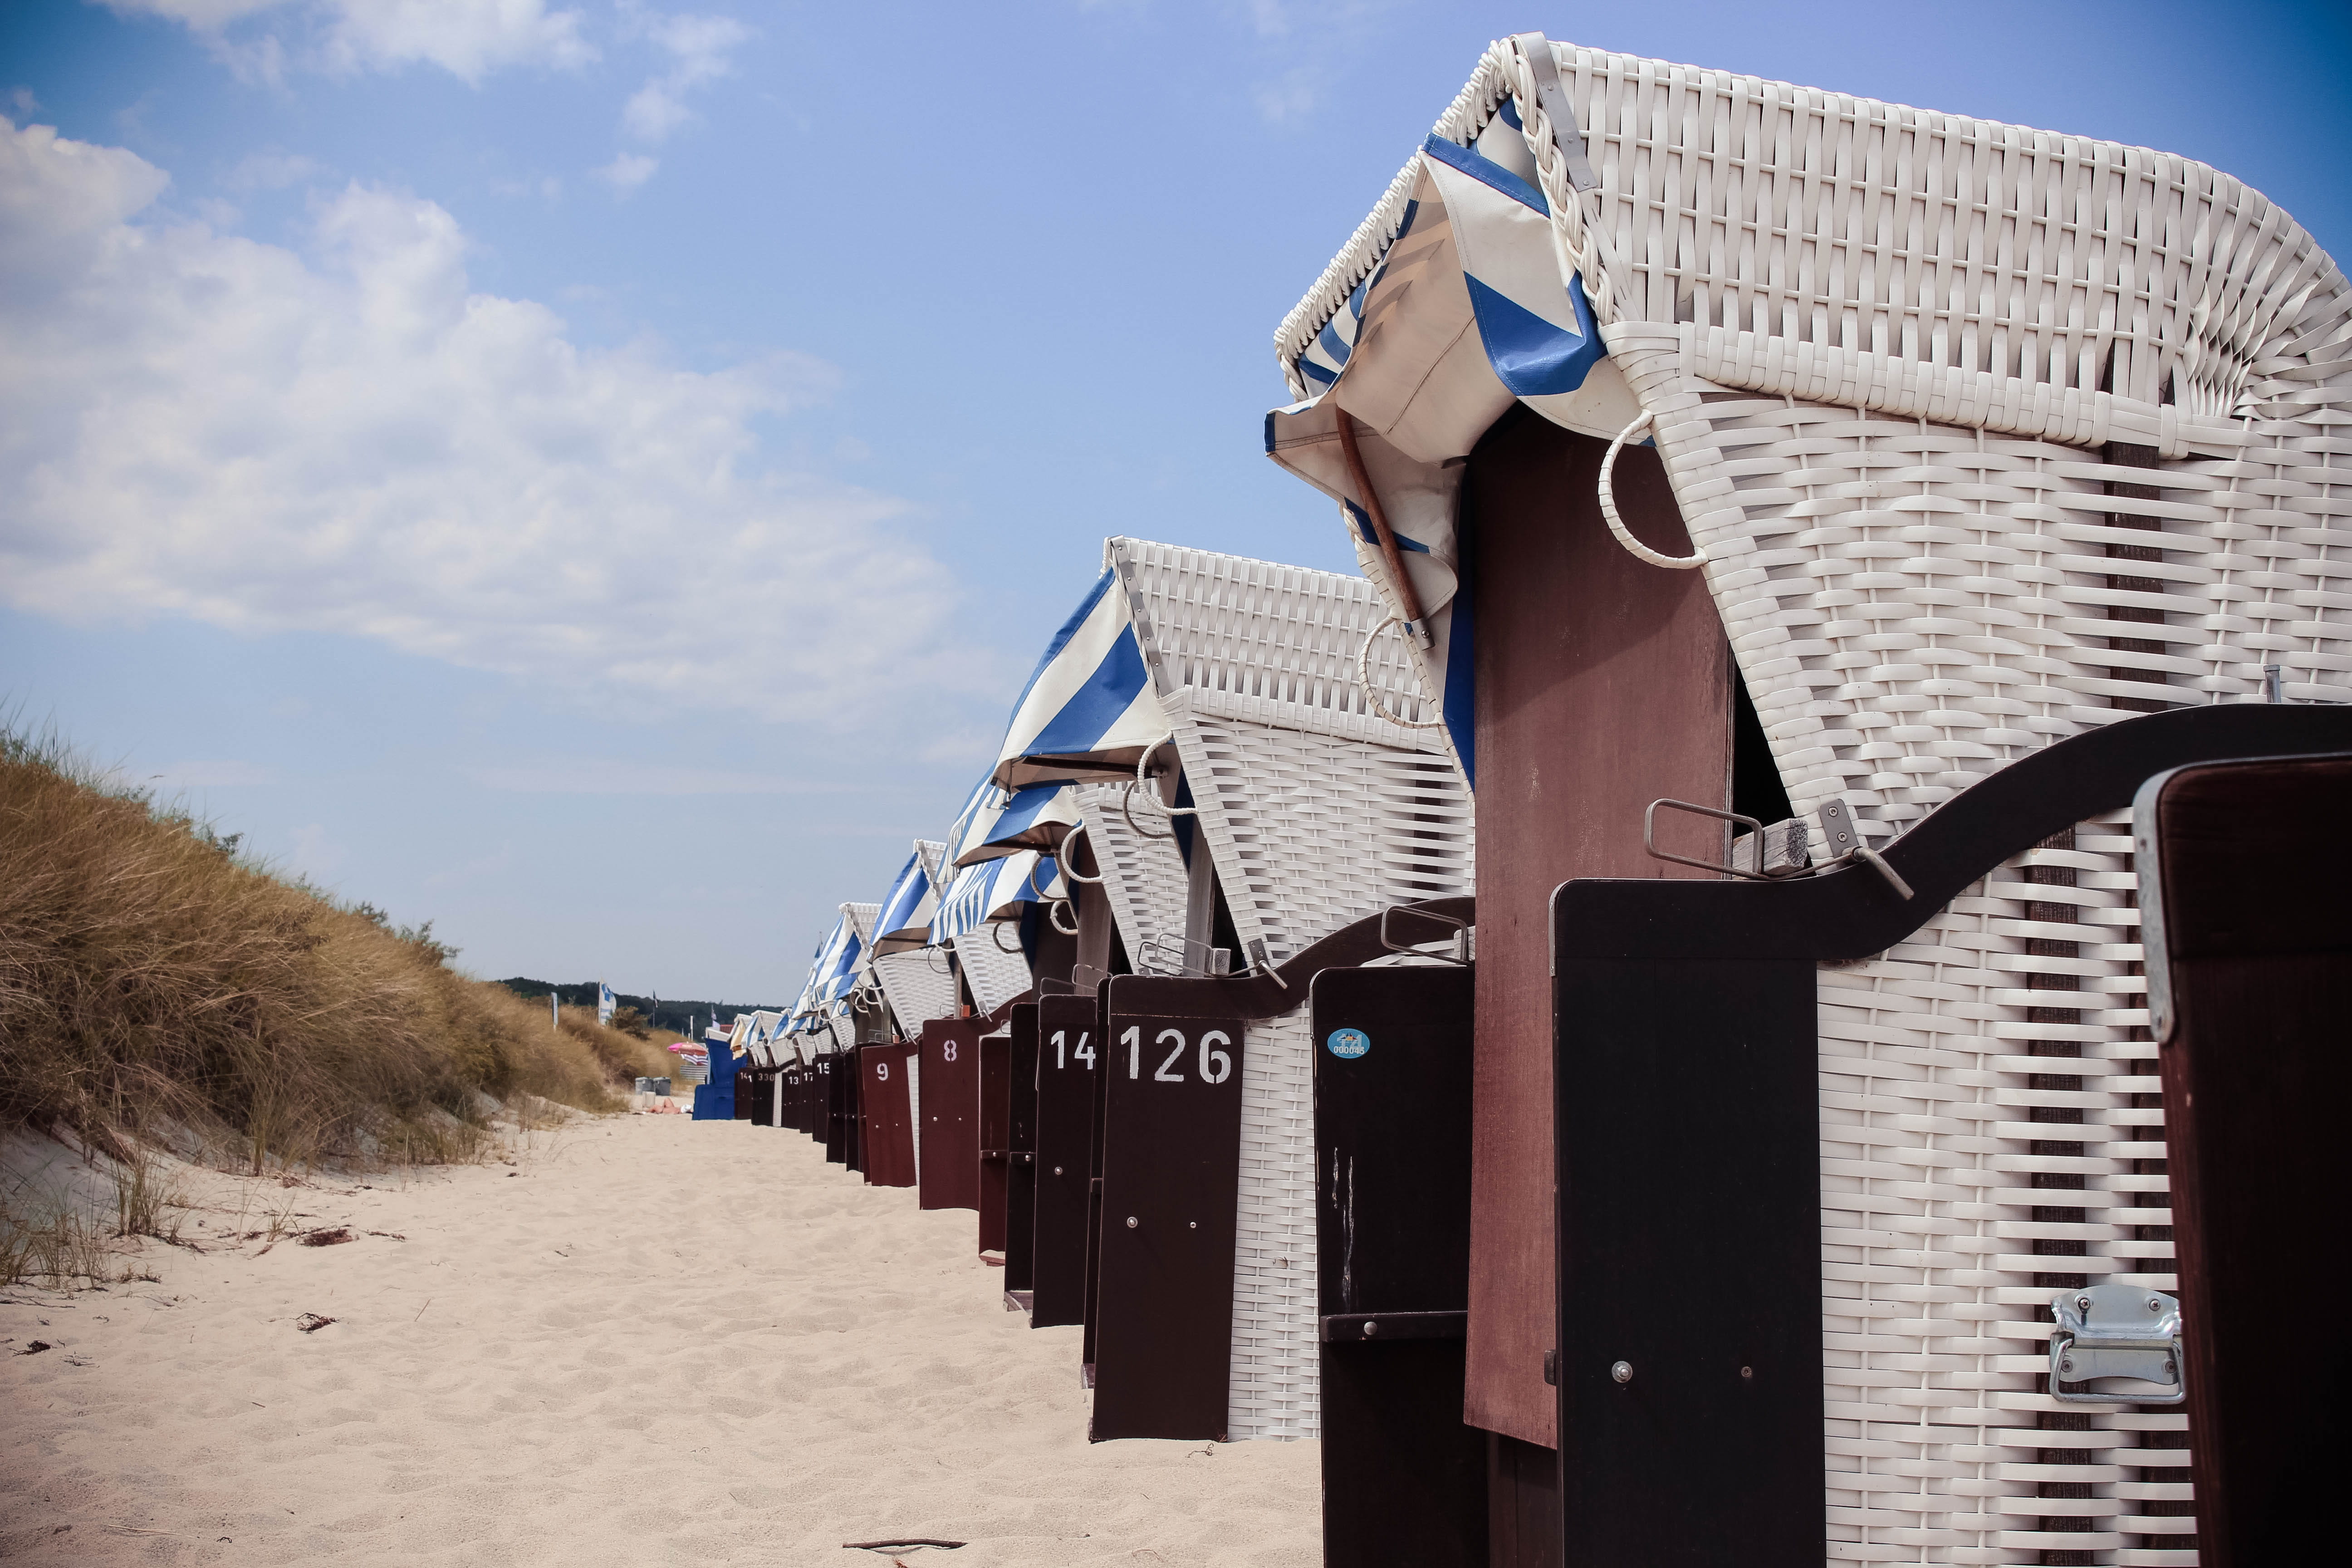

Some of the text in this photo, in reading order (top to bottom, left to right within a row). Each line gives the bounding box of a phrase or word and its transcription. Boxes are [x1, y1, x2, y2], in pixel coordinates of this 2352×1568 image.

[944, 1040, 957, 1061] 8
[1051, 1030, 1096, 1069] 14
[1121, 1026, 1231, 1084] 126
[817, 1063, 829, 1074] 15
[877, 1063, 888, 1081] 9
[758, 1073, 775, 1081] 330
[789, 1076, 799, 1084] 13
[804, 1072, 813, 1081] 17
